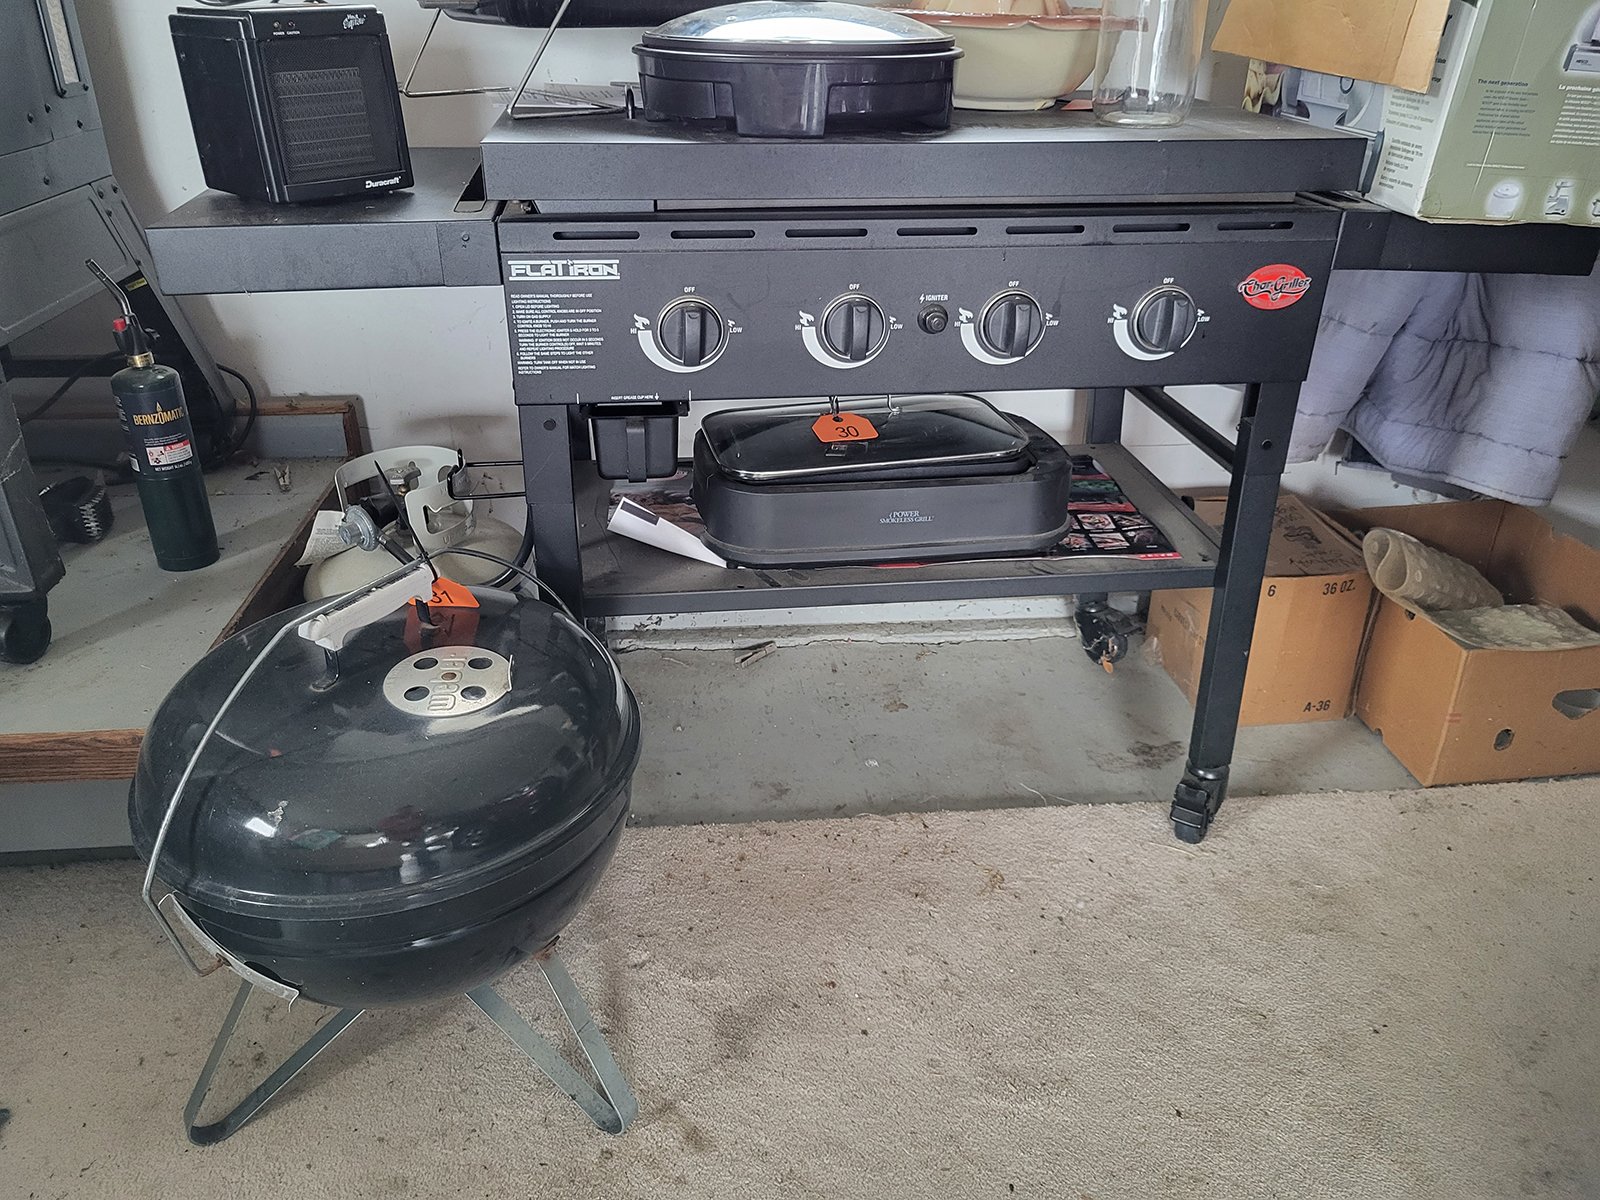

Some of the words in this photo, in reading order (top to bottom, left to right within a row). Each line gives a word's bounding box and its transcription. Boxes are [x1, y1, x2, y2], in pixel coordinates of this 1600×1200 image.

[366, 177, 400, 188] Duracraft
[132, 406, 184, 426] BERNZOMATIC
[835, 426, 859, 438] 30
[1267, 584, 1276, 597] 6
[1322, 582, 1338, 595] 36
[1340, 579, 1356, 593] OZ.
[427, 654, 467, 712] weber
[1302, 700, 1331, 712] A-36
